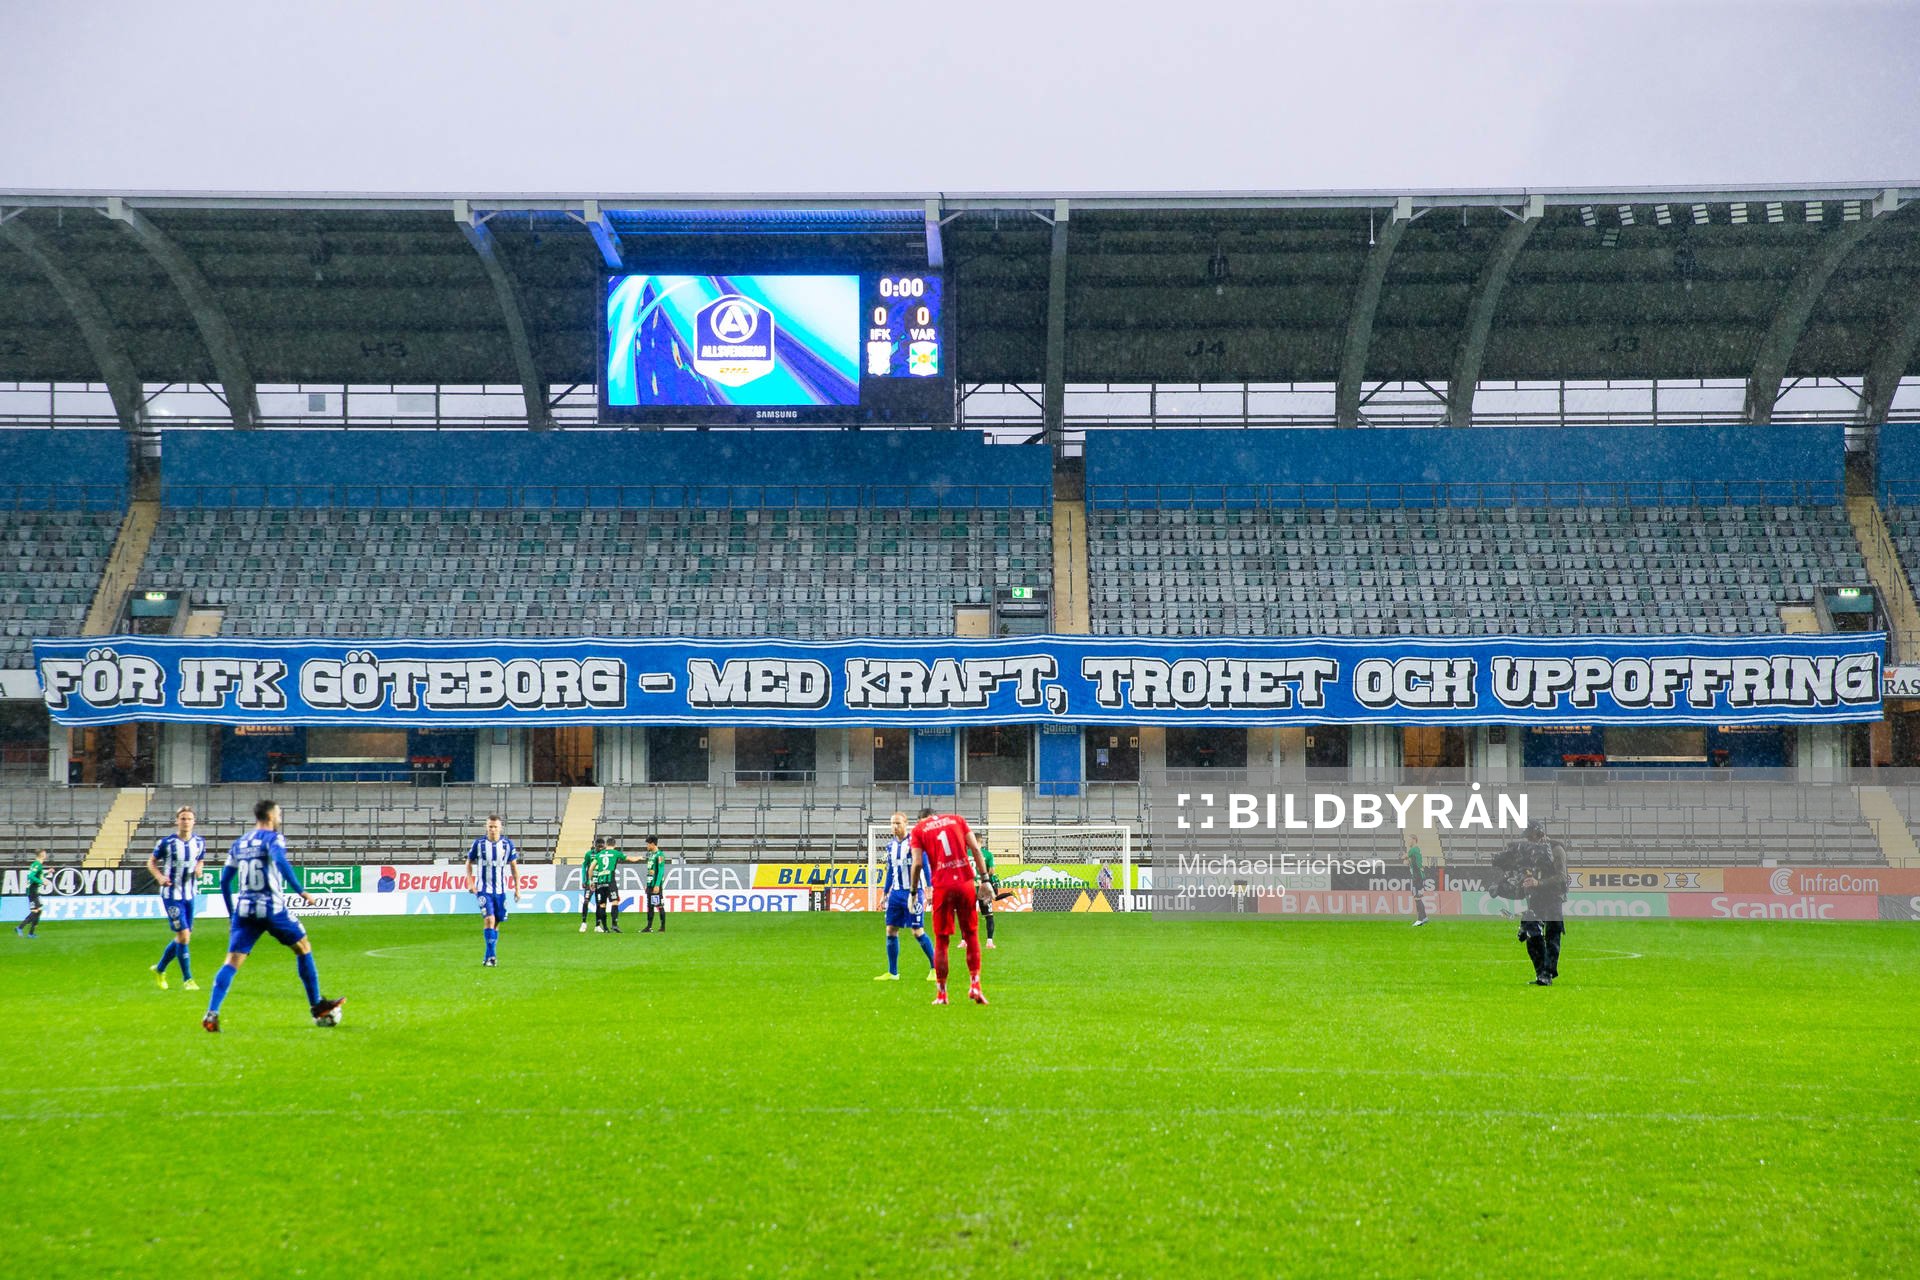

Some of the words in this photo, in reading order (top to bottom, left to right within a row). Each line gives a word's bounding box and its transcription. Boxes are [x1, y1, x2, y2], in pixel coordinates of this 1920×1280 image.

[880, 278, 923, 297] 0:00
[874, 307, 887, 325] 0
[917, 307, 930, 325] 0
[870, 328, 891, 341] IFK
[910, 328, 935, 341] VAR
[756, 410, 798, 419] SAMSUNG
[41, 648, 164, 709] FÖR
[181, 659, 288, 710] IFK
[301, 651, 627, 710] GÖTEBORG
[688, 658, 832, 710] MED
[844, 655, 1068, 715] KRAFT,
[1083, 657, 1339, 710] TROHET
[1354, 657, 1476, 710] OCH
[1491, 653, 1880, 710] UPPOFFRING
[937, 830, 952, 856] 1
[310, 871, 345, 885] MCR
[1445, 874, 1486, 891] law.
[1589, 873, 1659, 887] HECO
[1800, 873, 1879, 892] InfraCom
[1281, 894, 1438, 914] BAUHAUS
[1711, 896, 1835, 919] Scandic
